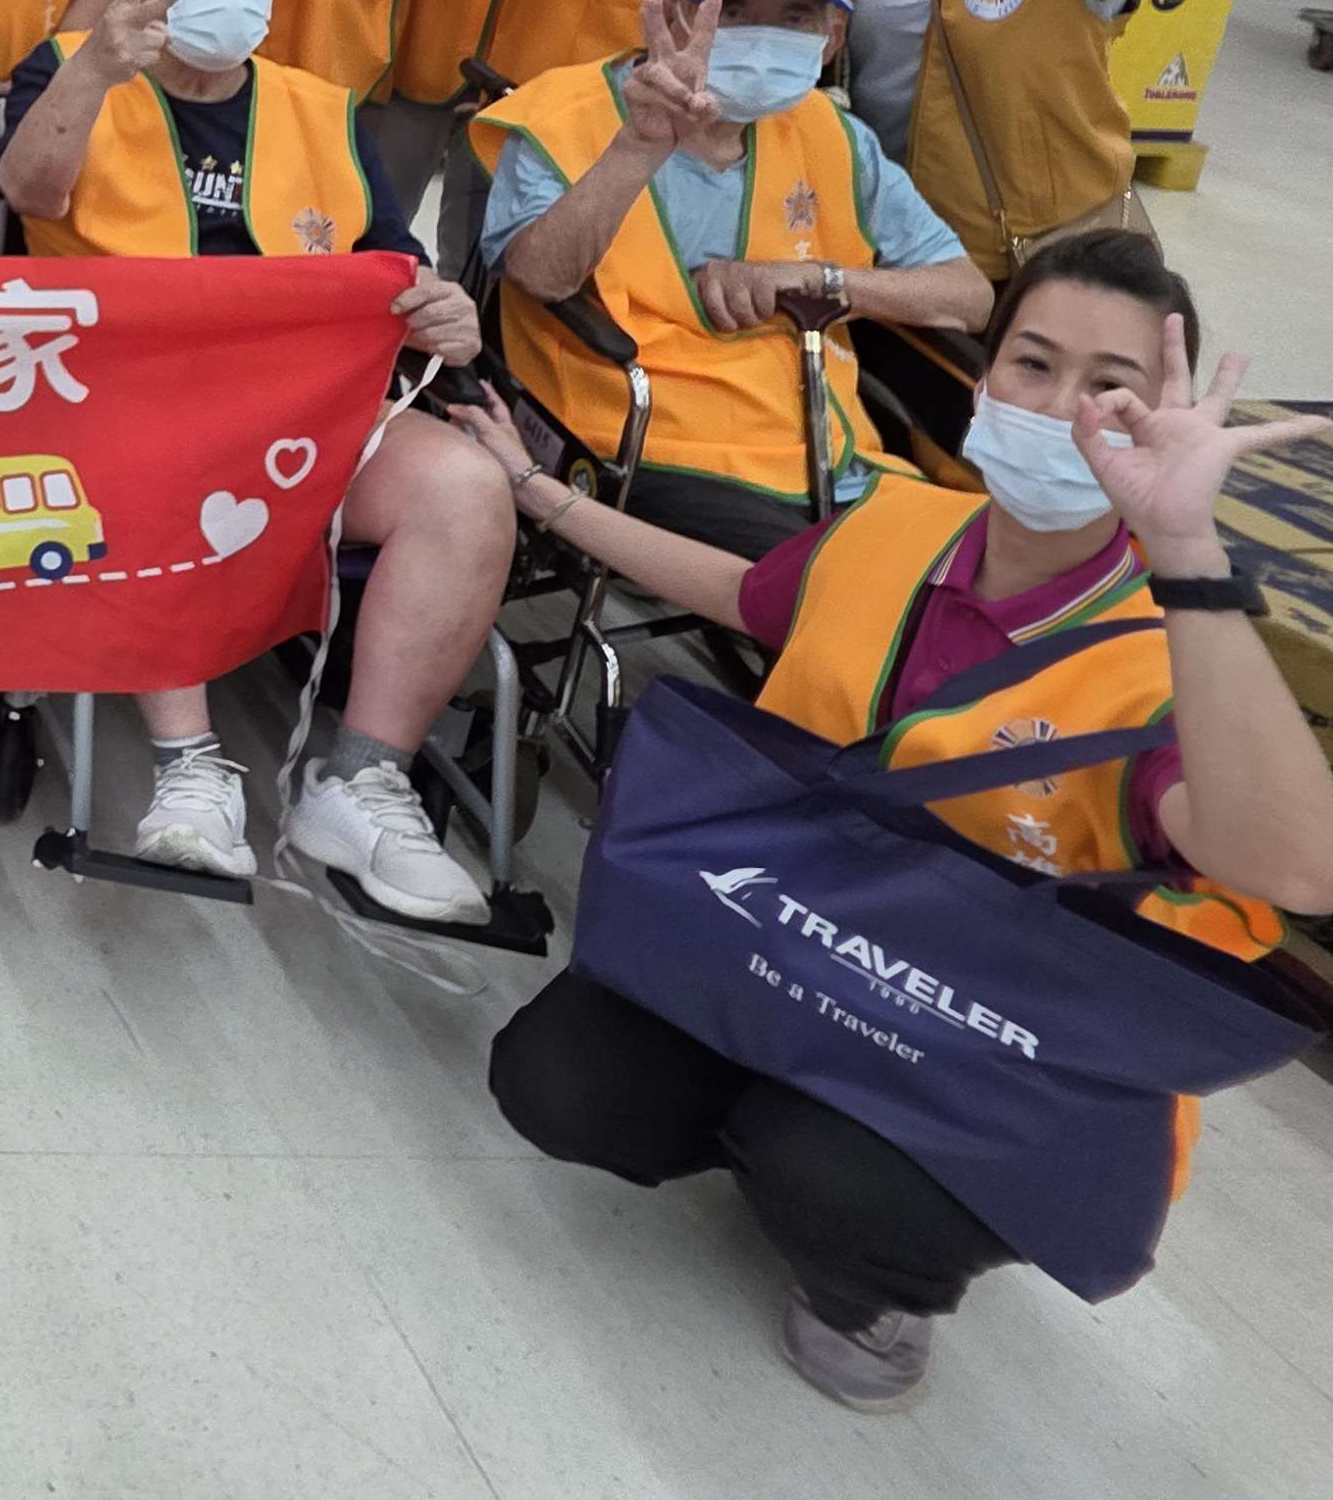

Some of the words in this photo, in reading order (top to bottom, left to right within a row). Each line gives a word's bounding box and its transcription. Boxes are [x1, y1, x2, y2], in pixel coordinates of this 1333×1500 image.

[746, 952, 782, 988] Be
[788, 983, 804, 1002] a
[814, 990, 926, 1065] Traveler
[778, 893, 1040, 1061] TRAVELER
